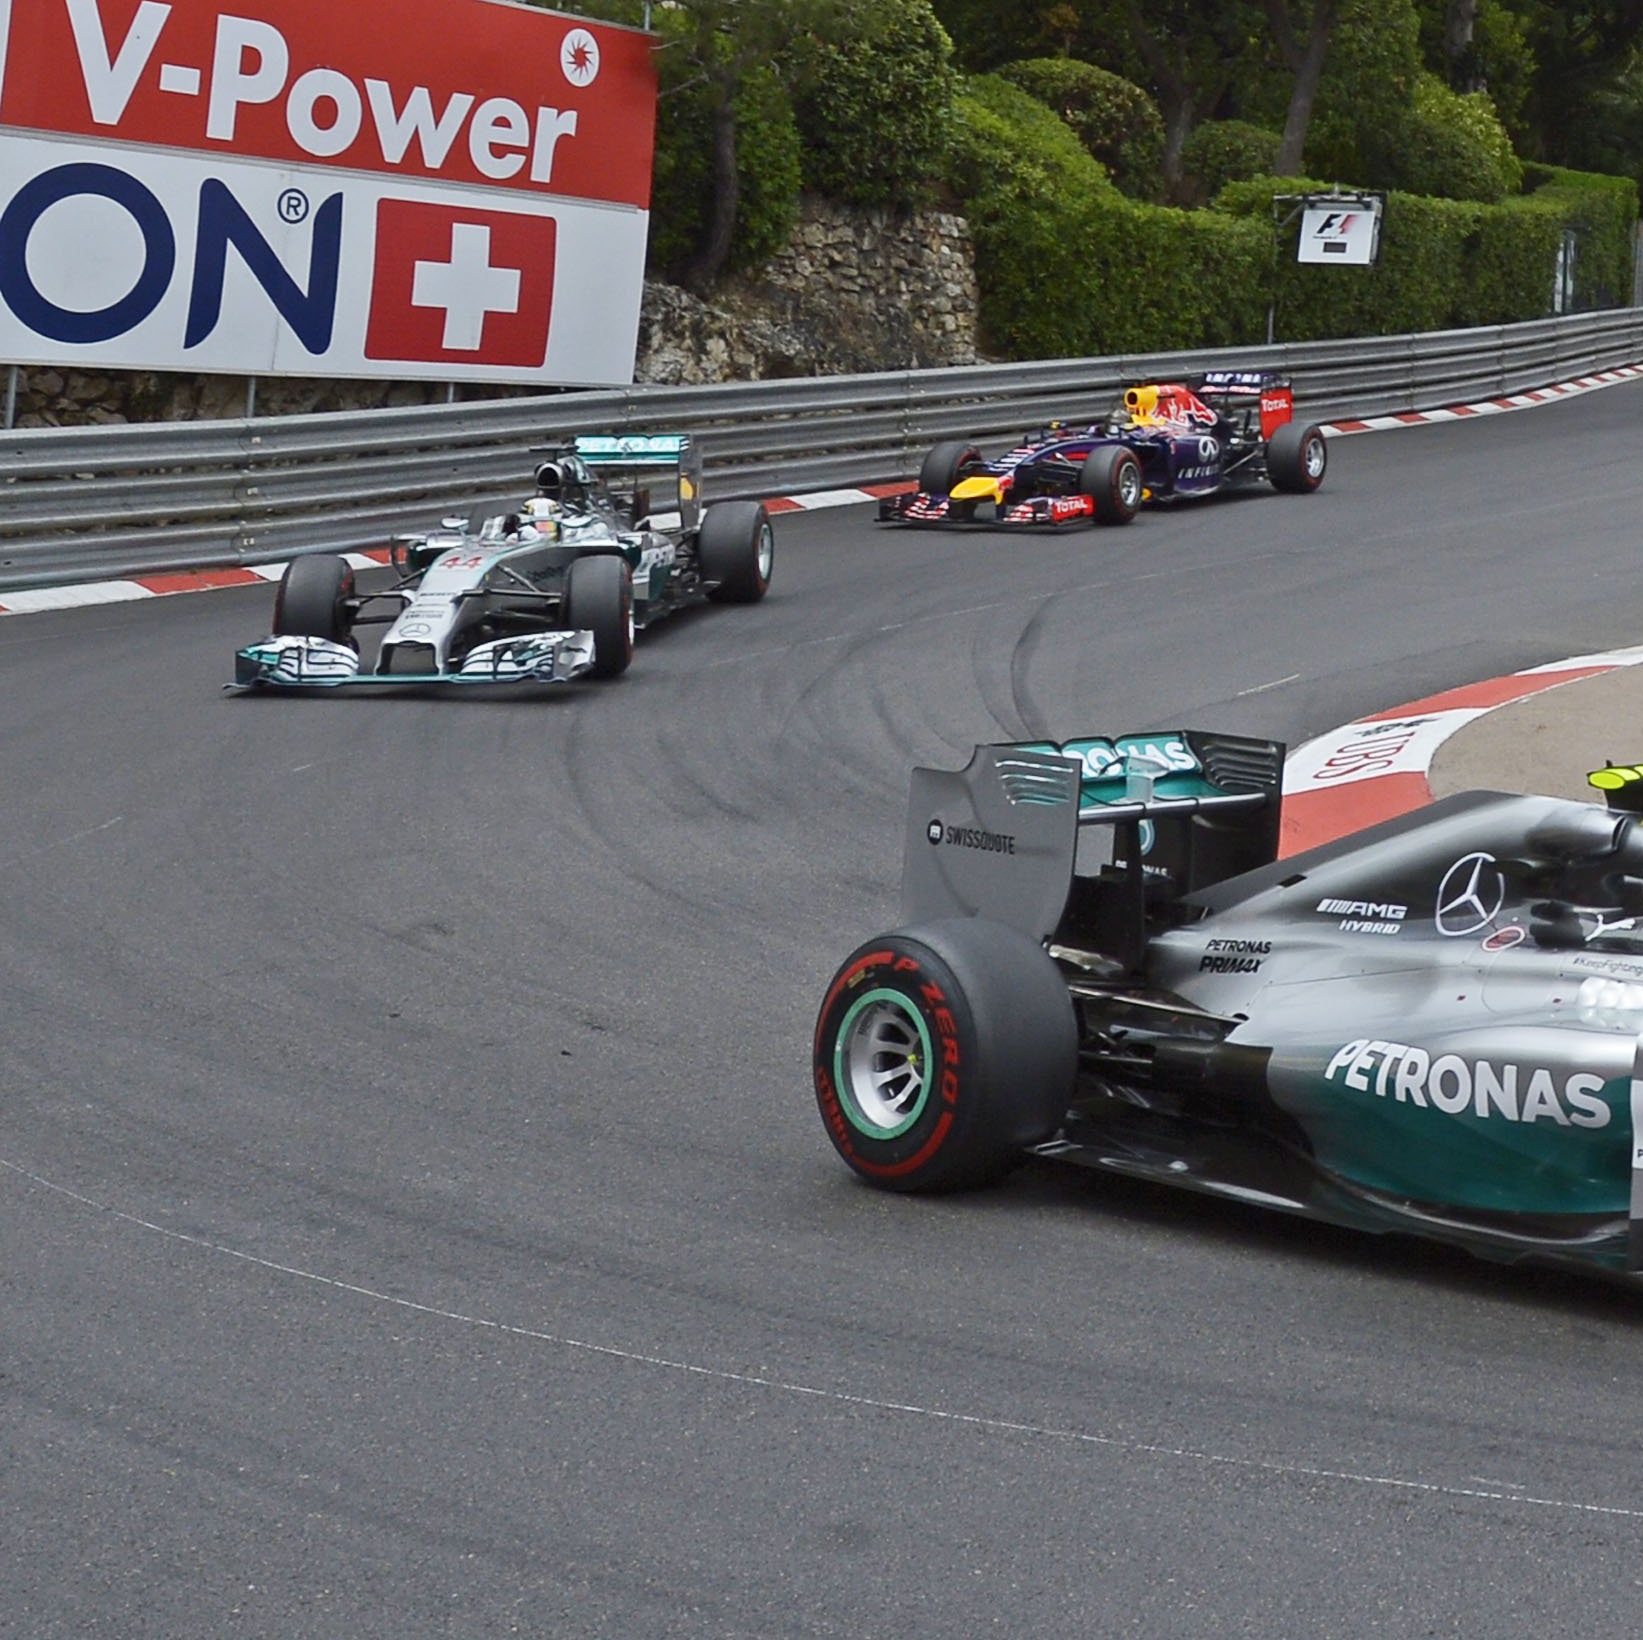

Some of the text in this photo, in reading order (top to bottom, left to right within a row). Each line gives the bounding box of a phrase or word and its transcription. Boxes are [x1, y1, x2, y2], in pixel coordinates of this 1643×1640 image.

[1055, 498, 1089, 513] TOTAL
[439, 556, 482, 569] 44
[1312, 731, 1416, 780] UBS
[1348, 902, 1408, 919] AMG
[1339, 920, 1400, 934] HYBRID
[1205, 939, 1272, 954] PETRONAS
[1325, 1039, 1611, 1129] PETRONAS
